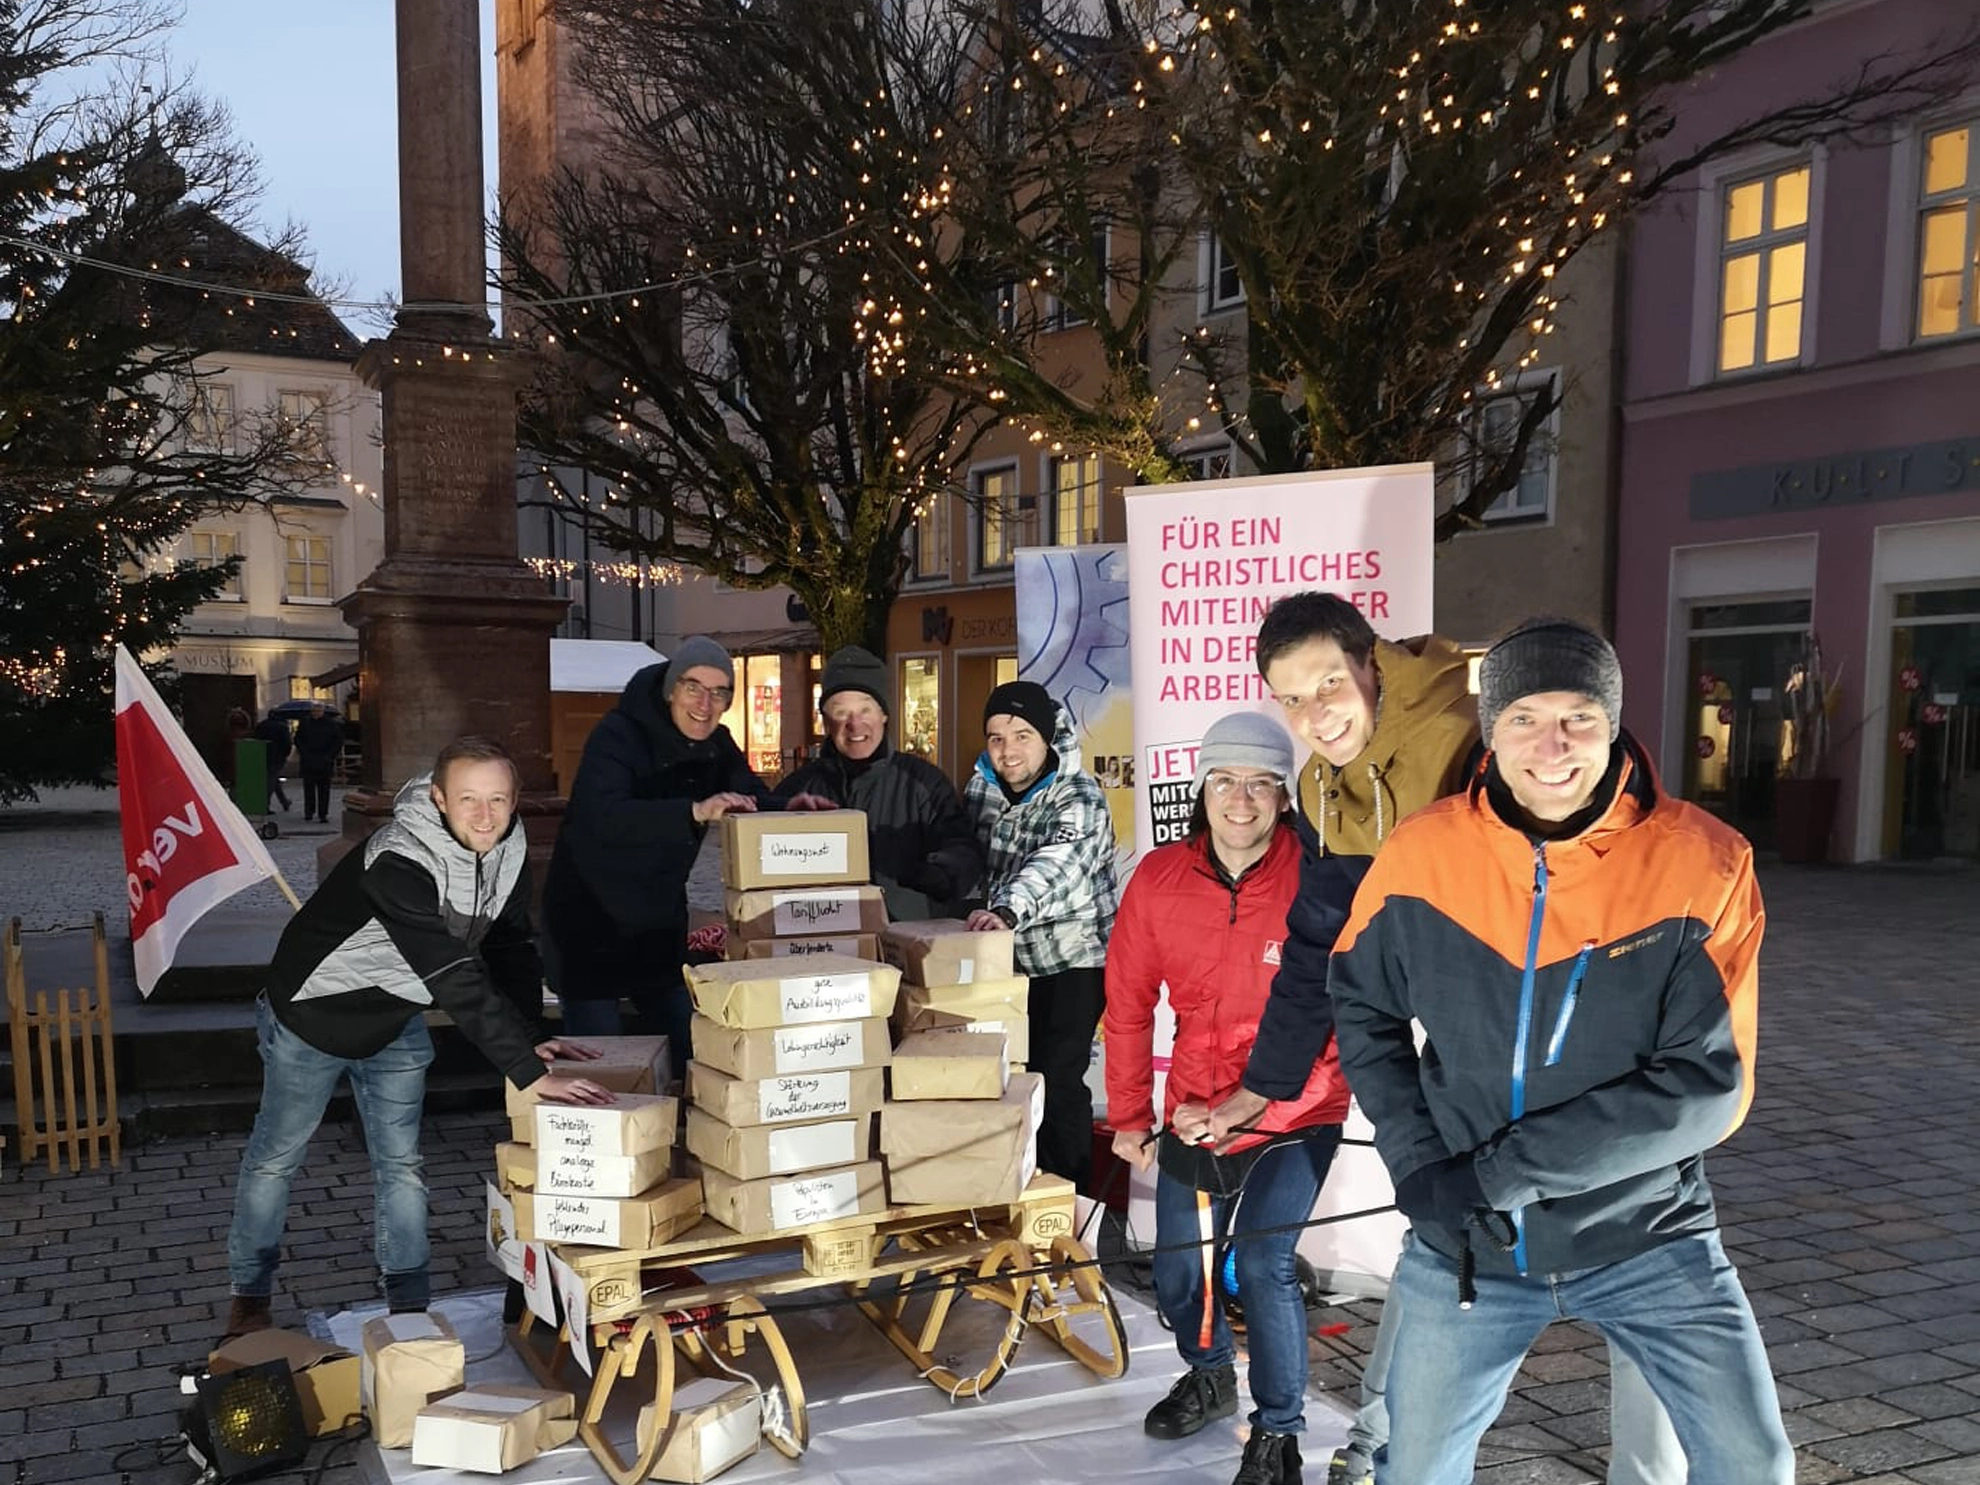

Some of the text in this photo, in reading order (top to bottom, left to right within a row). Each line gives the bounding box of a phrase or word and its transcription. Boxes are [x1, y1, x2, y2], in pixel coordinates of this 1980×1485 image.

[1162, 516, 1281, 551] FÜR EIN
[1161, 550, 1381, 588] CHRISTLICHES
[1162, 591, 1389, 627] MITEINER
[184, 654, 254, 668] MUSUM
[1161, 637, 1191, 664] IN
[1160, 673, 1277, 701] ARBEIT
[771, 842, 829, 862] Wohnungsnot
[784, 900, 843, 924] Tarifflucht
[778, 1079, 819, 1092] Stärkung
[1039, 1217, 1066, 1233] EPAL
[597, 1283, 629, 1303] EPAL
